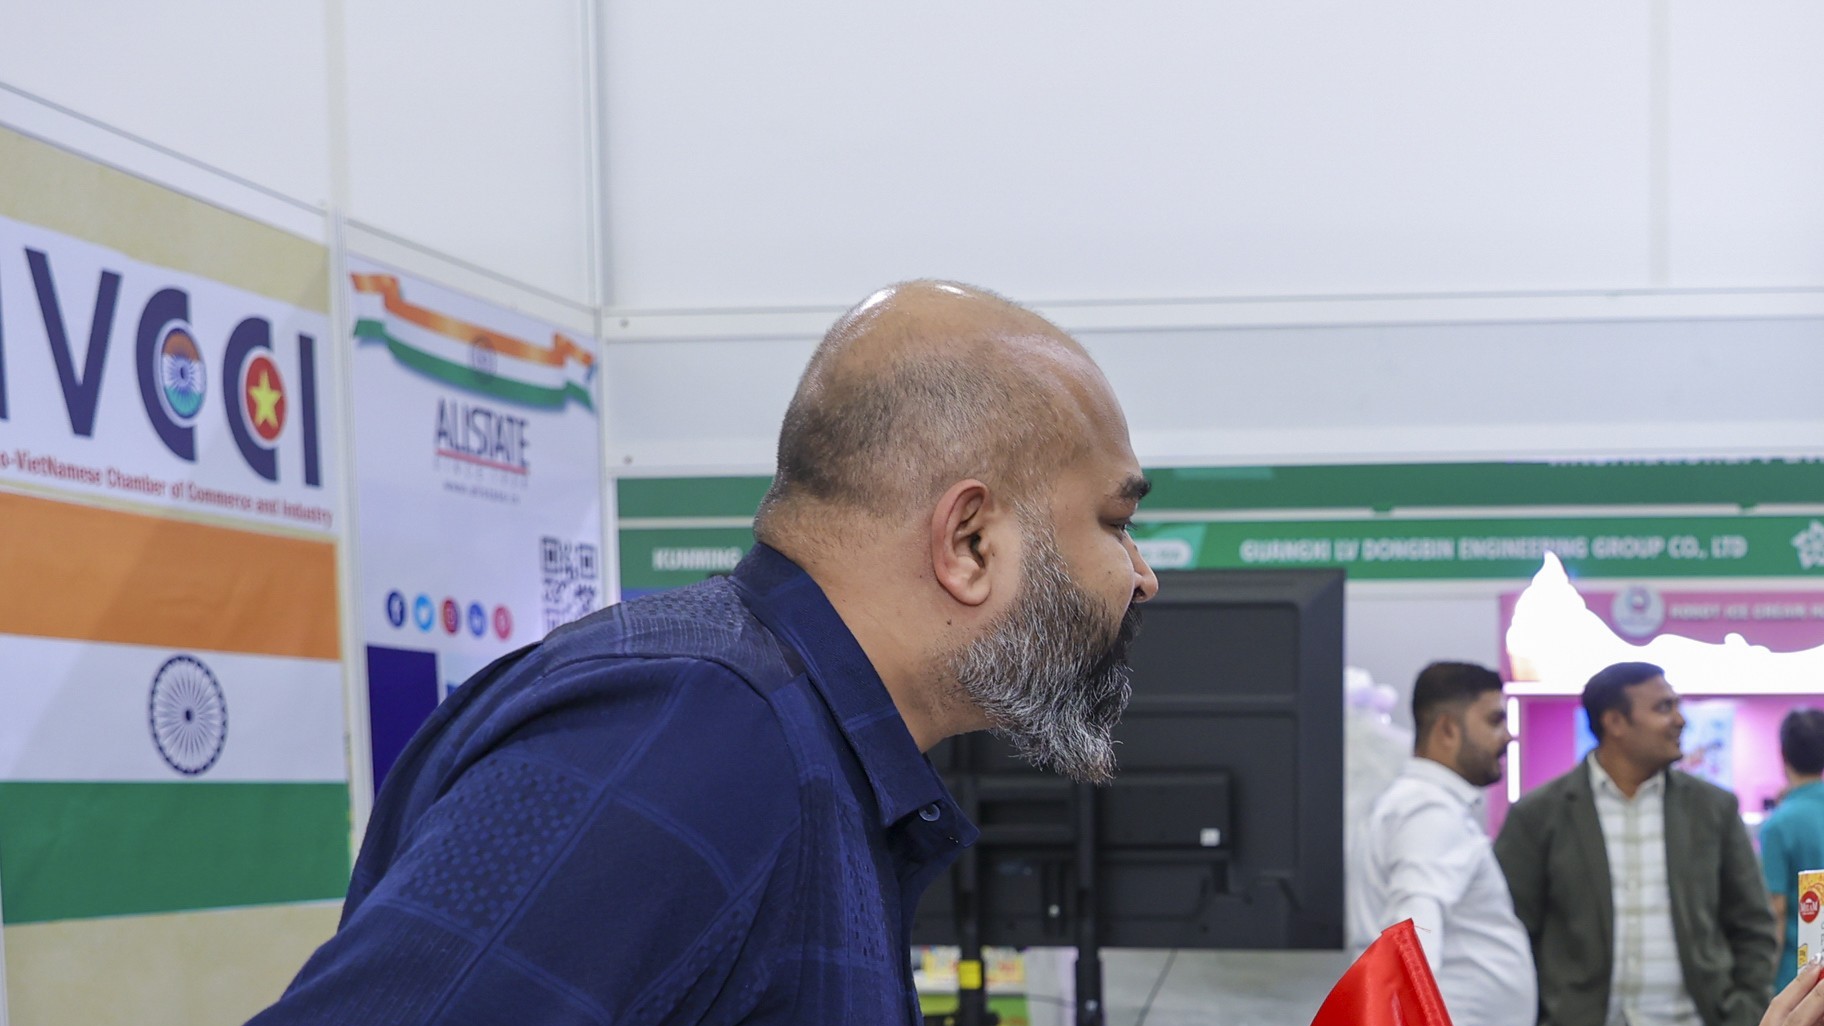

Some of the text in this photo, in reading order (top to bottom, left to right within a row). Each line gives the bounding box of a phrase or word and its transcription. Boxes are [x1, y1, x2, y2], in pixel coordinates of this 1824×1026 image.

[0, 246, 322, 488] VCCI
[107, 467, 166, 496] Chamber
[172, 481, 184, 499] of
[188, 483, 251, 511] Commerce
[256, 498, 277, 515] and
[283, 501, 333, 530] Industry
[1458, 536, 1589, 560] ENGINEERING
[1591, 535, 1665, 559] GROUP
[1711, 535, 1747, 558] LTD
